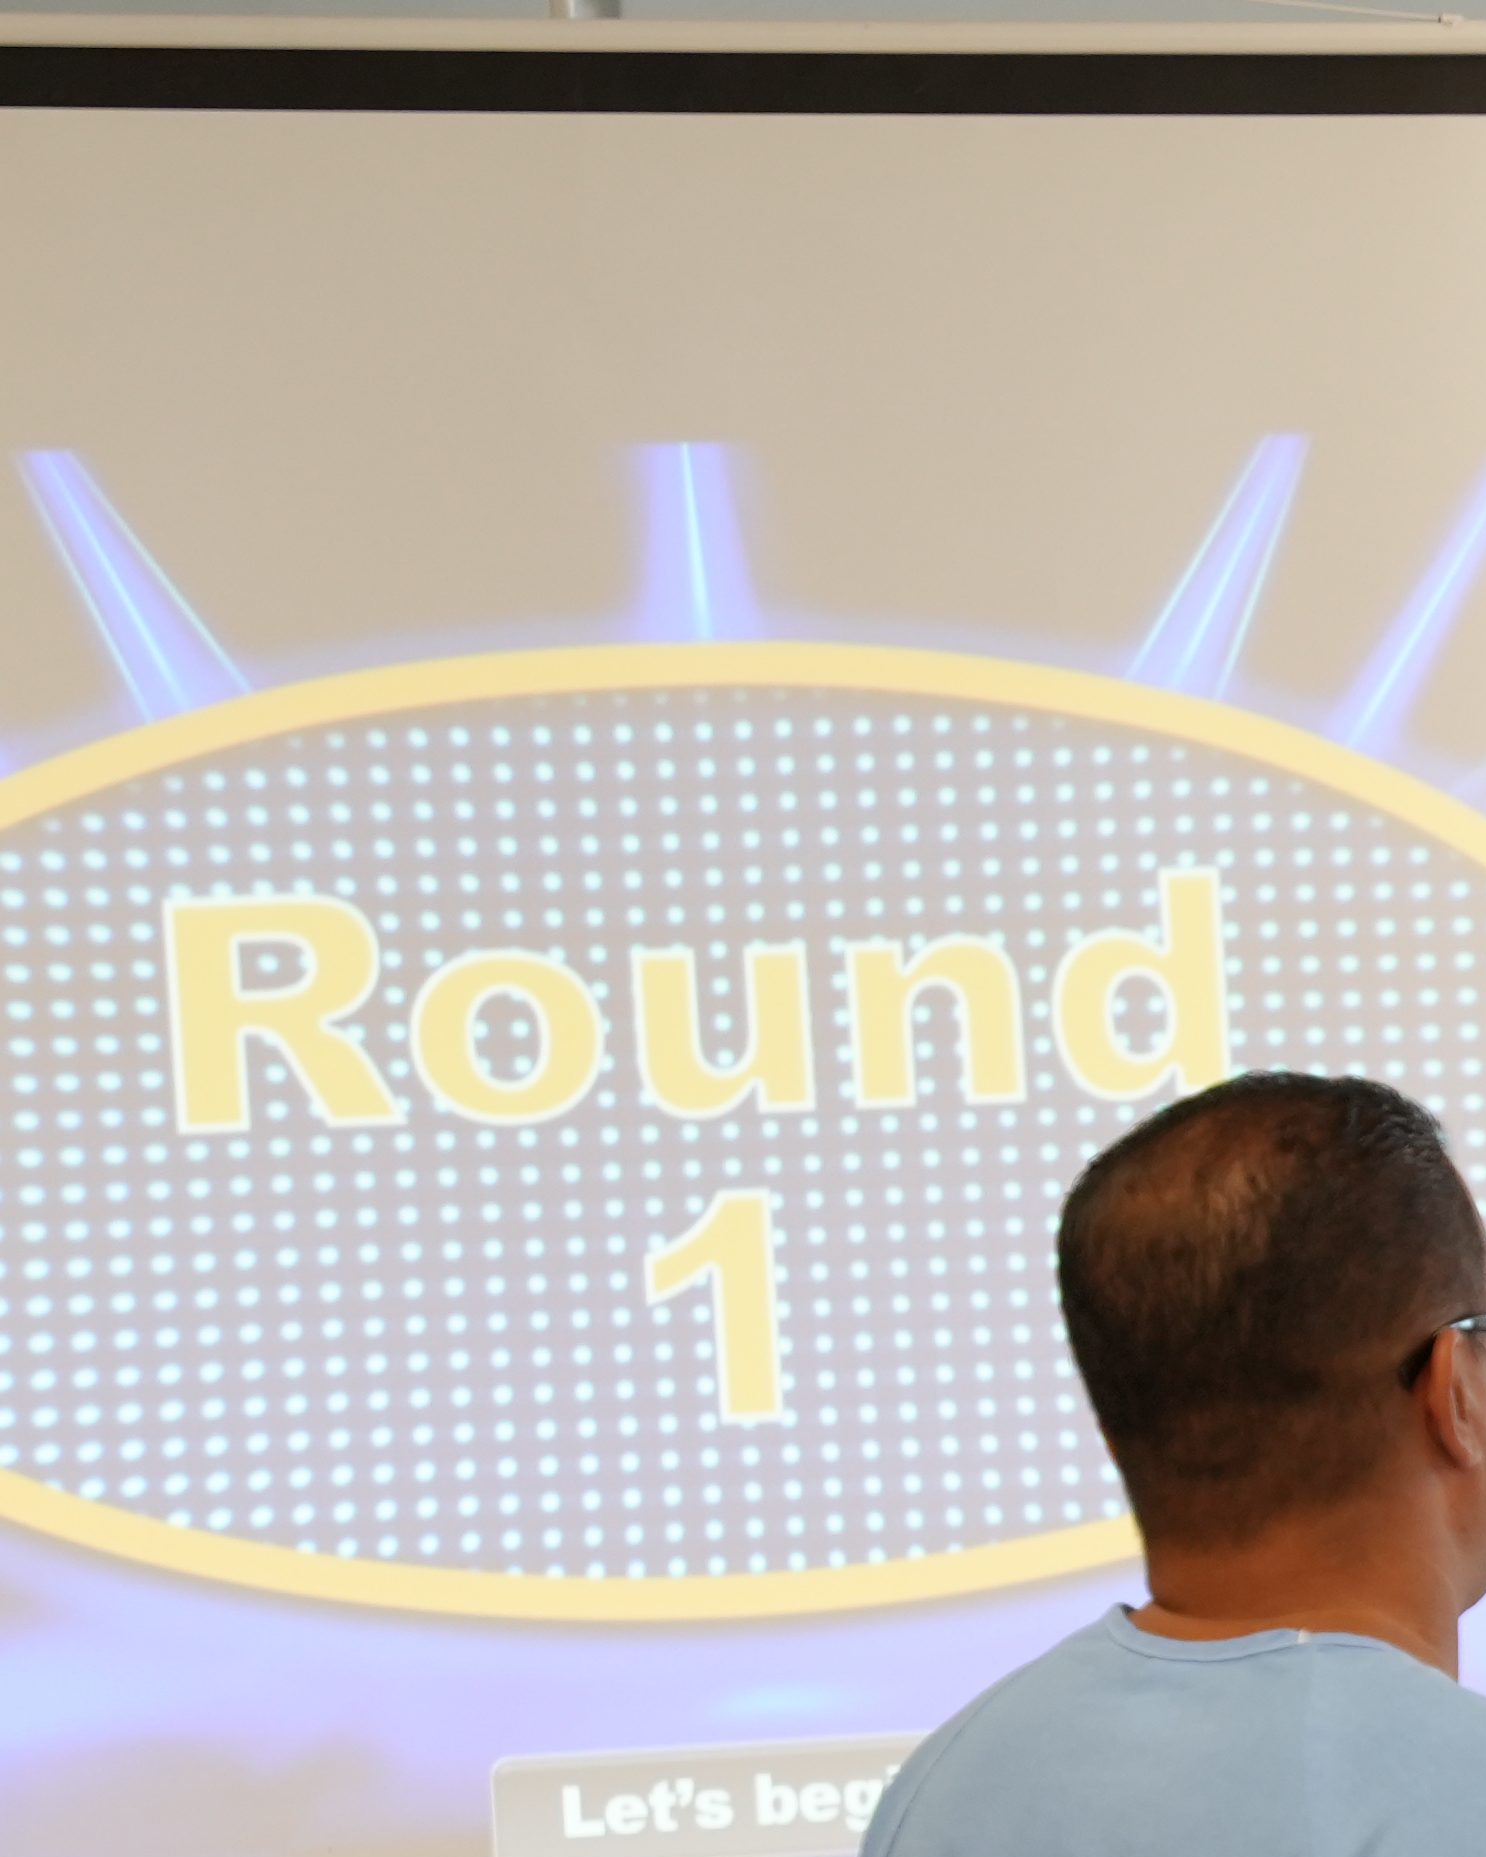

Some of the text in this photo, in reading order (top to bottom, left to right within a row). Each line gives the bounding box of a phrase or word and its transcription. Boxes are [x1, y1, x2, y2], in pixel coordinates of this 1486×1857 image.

[162, 866, 1233, 1136] Round
[643, 1187, 785, 1426] 1
[562, 1777, 734, 1839] Let's
